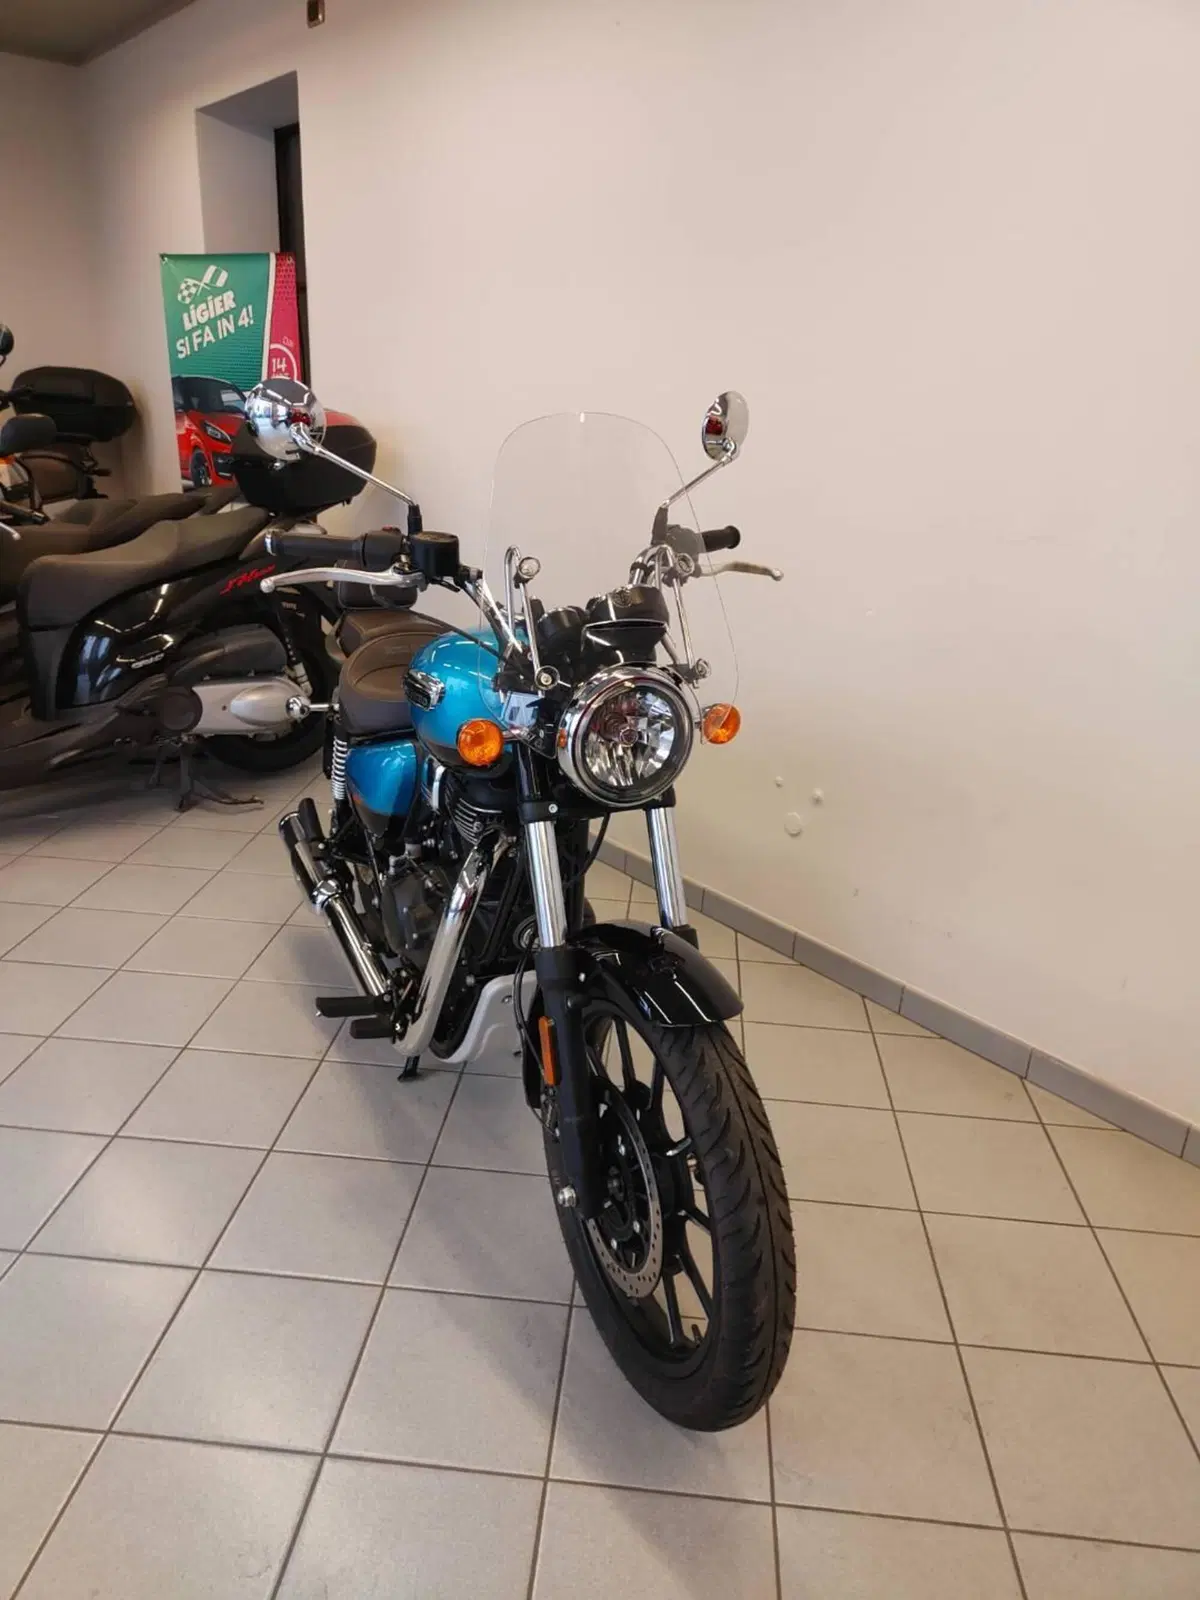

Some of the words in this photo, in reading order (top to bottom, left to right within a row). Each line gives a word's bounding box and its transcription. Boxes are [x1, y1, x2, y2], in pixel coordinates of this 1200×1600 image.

[176, 336, 191, 359] SI
[192, 325, 216, 352] FA
[217, 314, 235, 340] IN
[238, 304, 254, 328] 4!
[272, 357, 288, 373] 14
